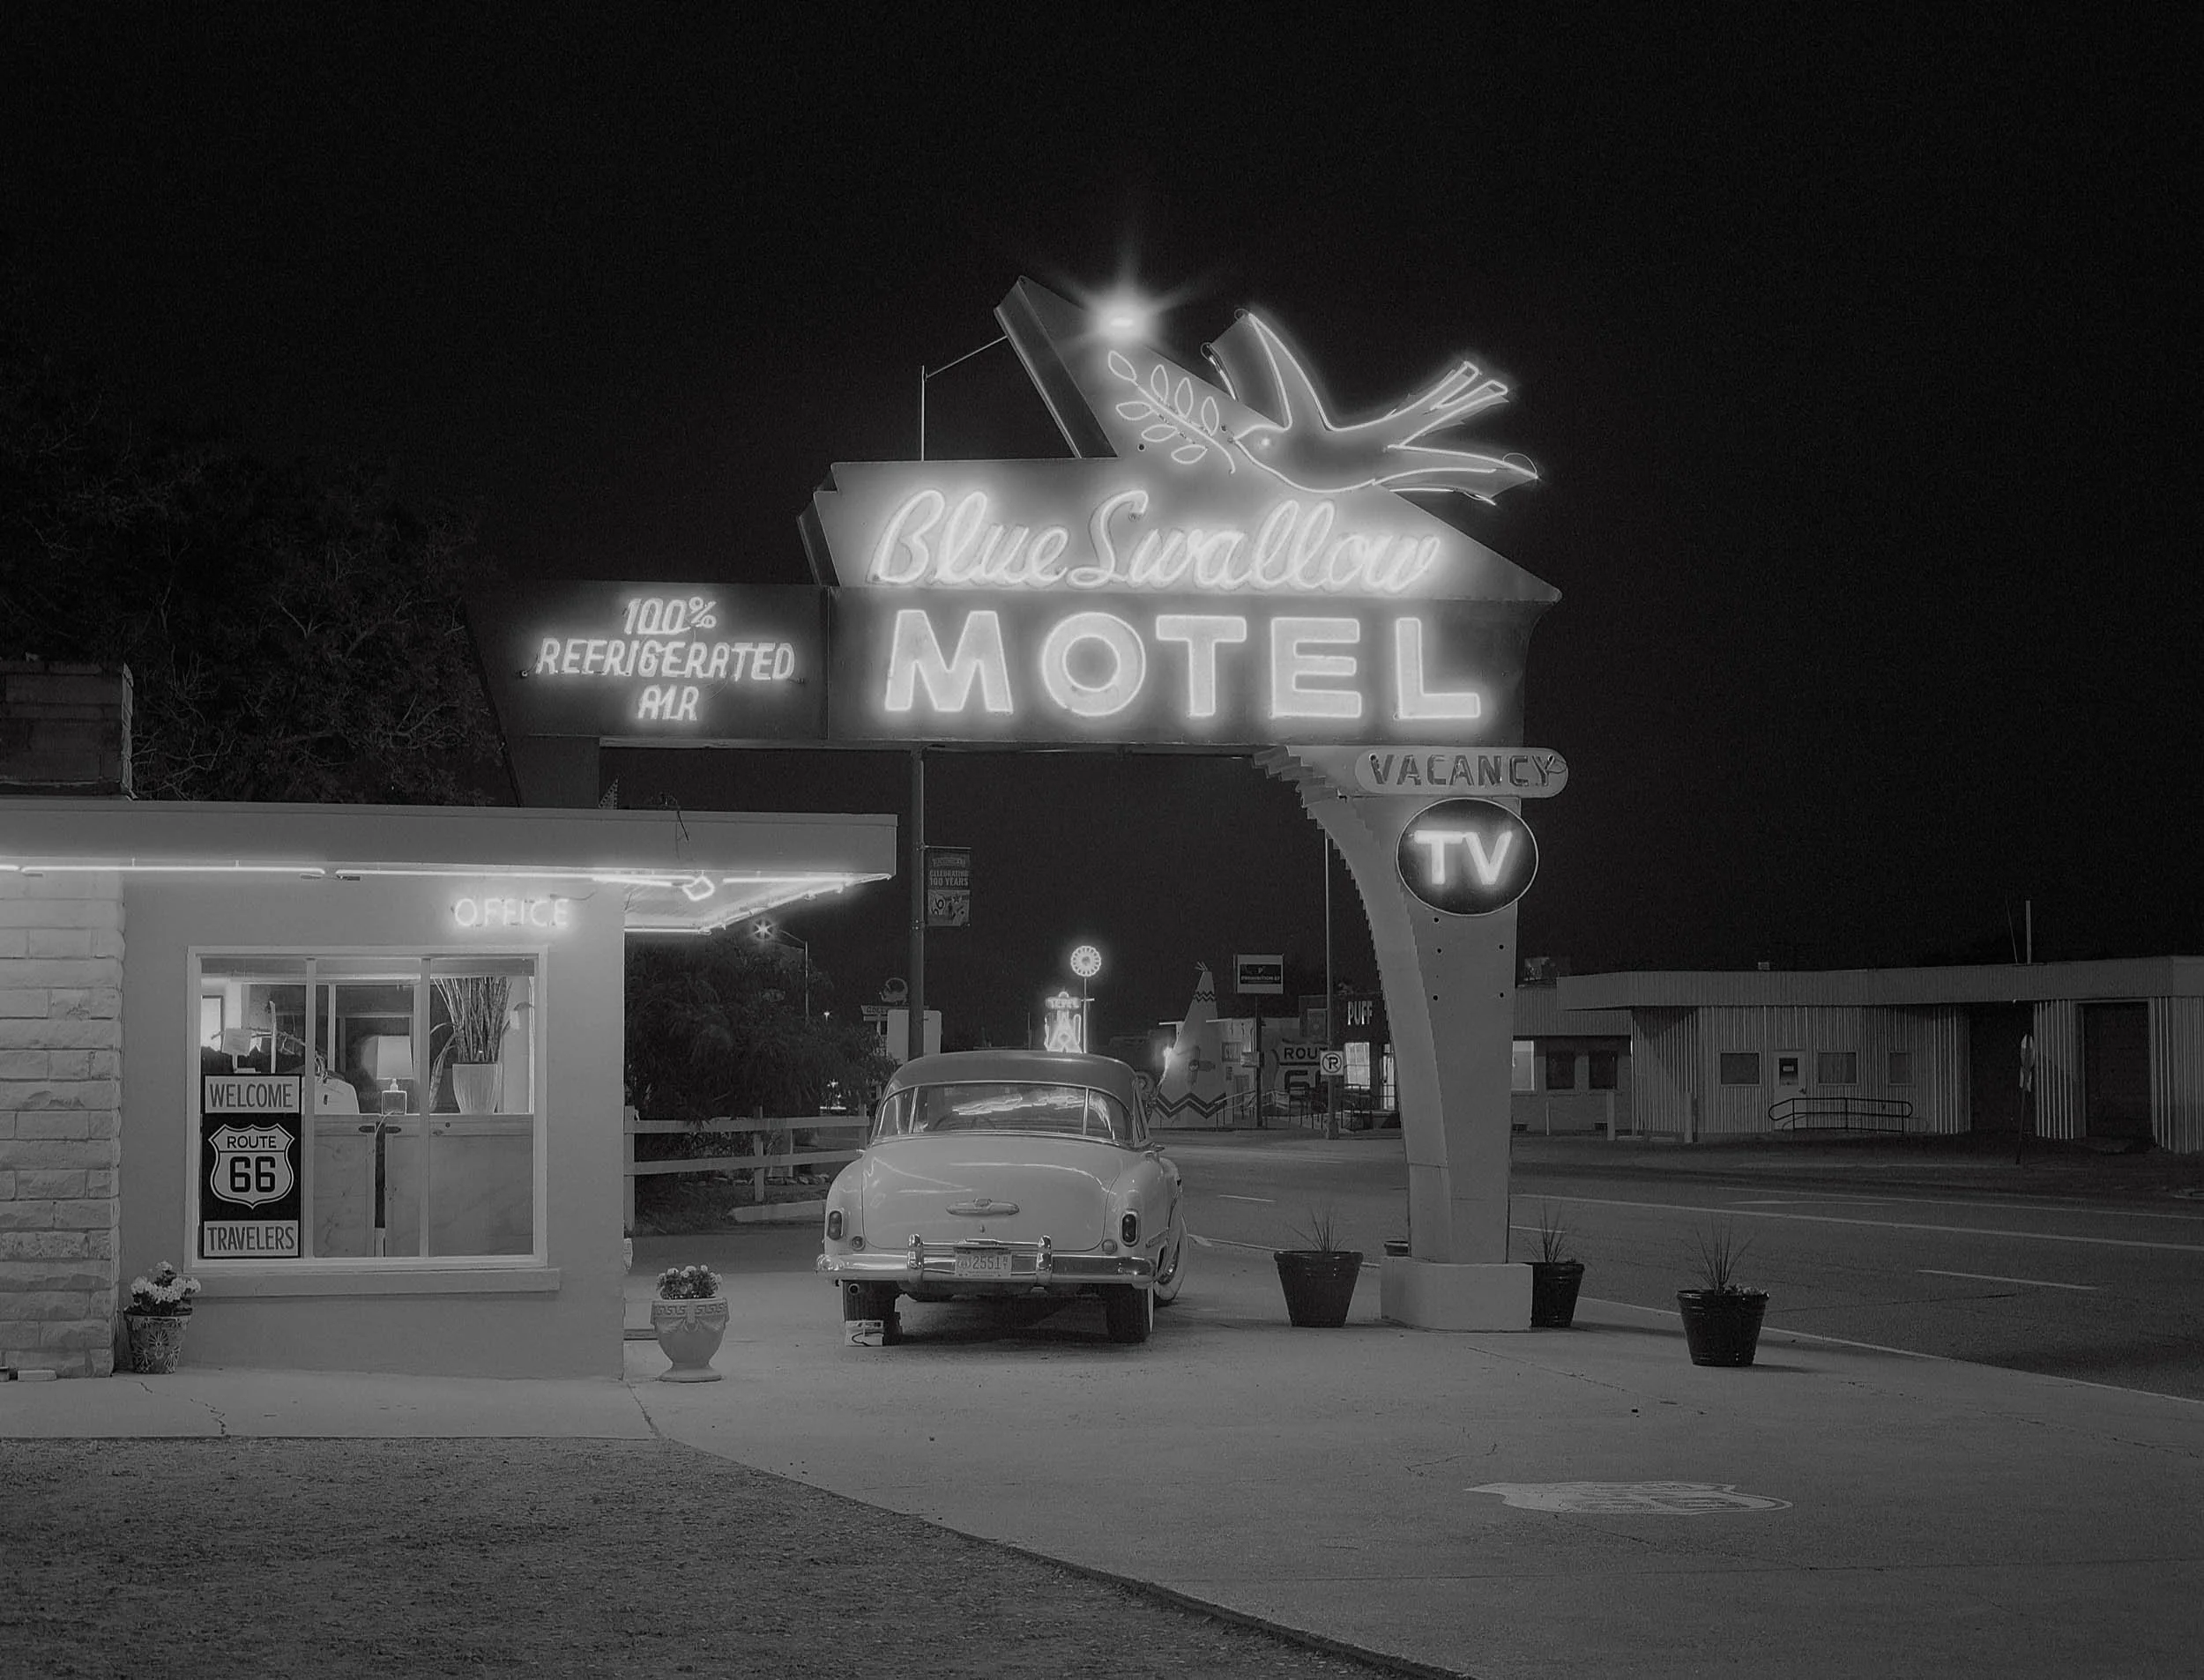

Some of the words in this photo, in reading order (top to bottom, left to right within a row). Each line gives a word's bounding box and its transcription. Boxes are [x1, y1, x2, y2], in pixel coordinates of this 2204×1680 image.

[867, 489, 1068, 588] Blue
[1066, 487, 1442, 592] Swallow
[623, 596, 717, 636] 100%
[535, 636, 795, 681] REFRIGERATED
[883, 608, 1482, 719] MOTEL
[637, 684, 699, 721] AIR
[1368, 754, 1556, 787] VACANCY
[1412, 829, 1514, 886] TV
[929, 877, 943, 887] 100
[945, 877, 969, 887] YEARS
[452, 897, 571, 928] OFFICE
[1347, 1000, 1373, 1026] PUFF
[209, 1082, 294, 1110] WELCOME
[226, 1134, 277, 1149] ROUTE
[229, 1156, 276, 1193] 66
[206, 1225, 295, 1251] TRAVELERS
